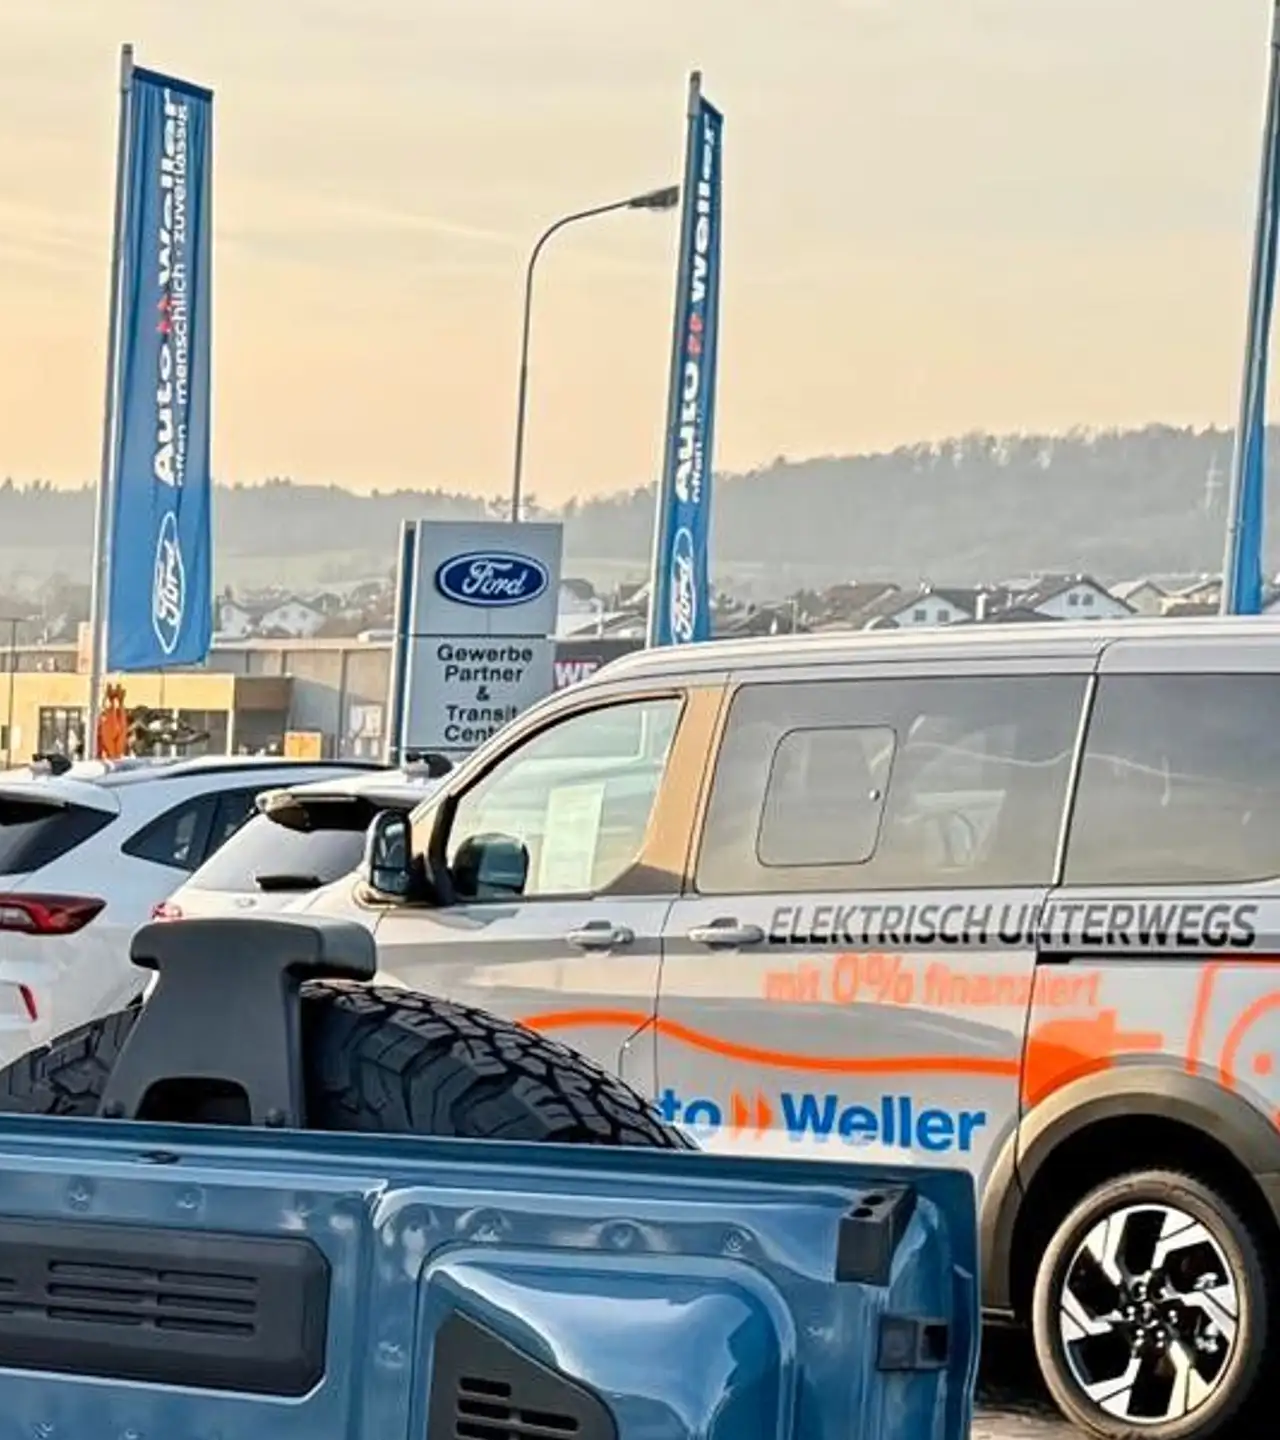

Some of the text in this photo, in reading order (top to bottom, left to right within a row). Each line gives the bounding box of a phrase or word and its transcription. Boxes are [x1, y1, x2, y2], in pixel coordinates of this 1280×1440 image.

[154, 88, 176, 487] Auto Weller
[171, 263, 187, 405] menschlich
[675, 361, 699, 504] Auto
[461, 560, 528, 596] Ford
[437, 644, 533, 662] Gewerbe
[445, 665, 523, 683] Partner
[445, 704, 517, 722] Transit
[476, 685, 490, 702] &
[768, 904, 1258, 948] ELEKTRISCH UNTERWEGS
[763, 954, 1103, 1008] mit 0% finanziert
[781, 1092, 987, 1151] Weller
